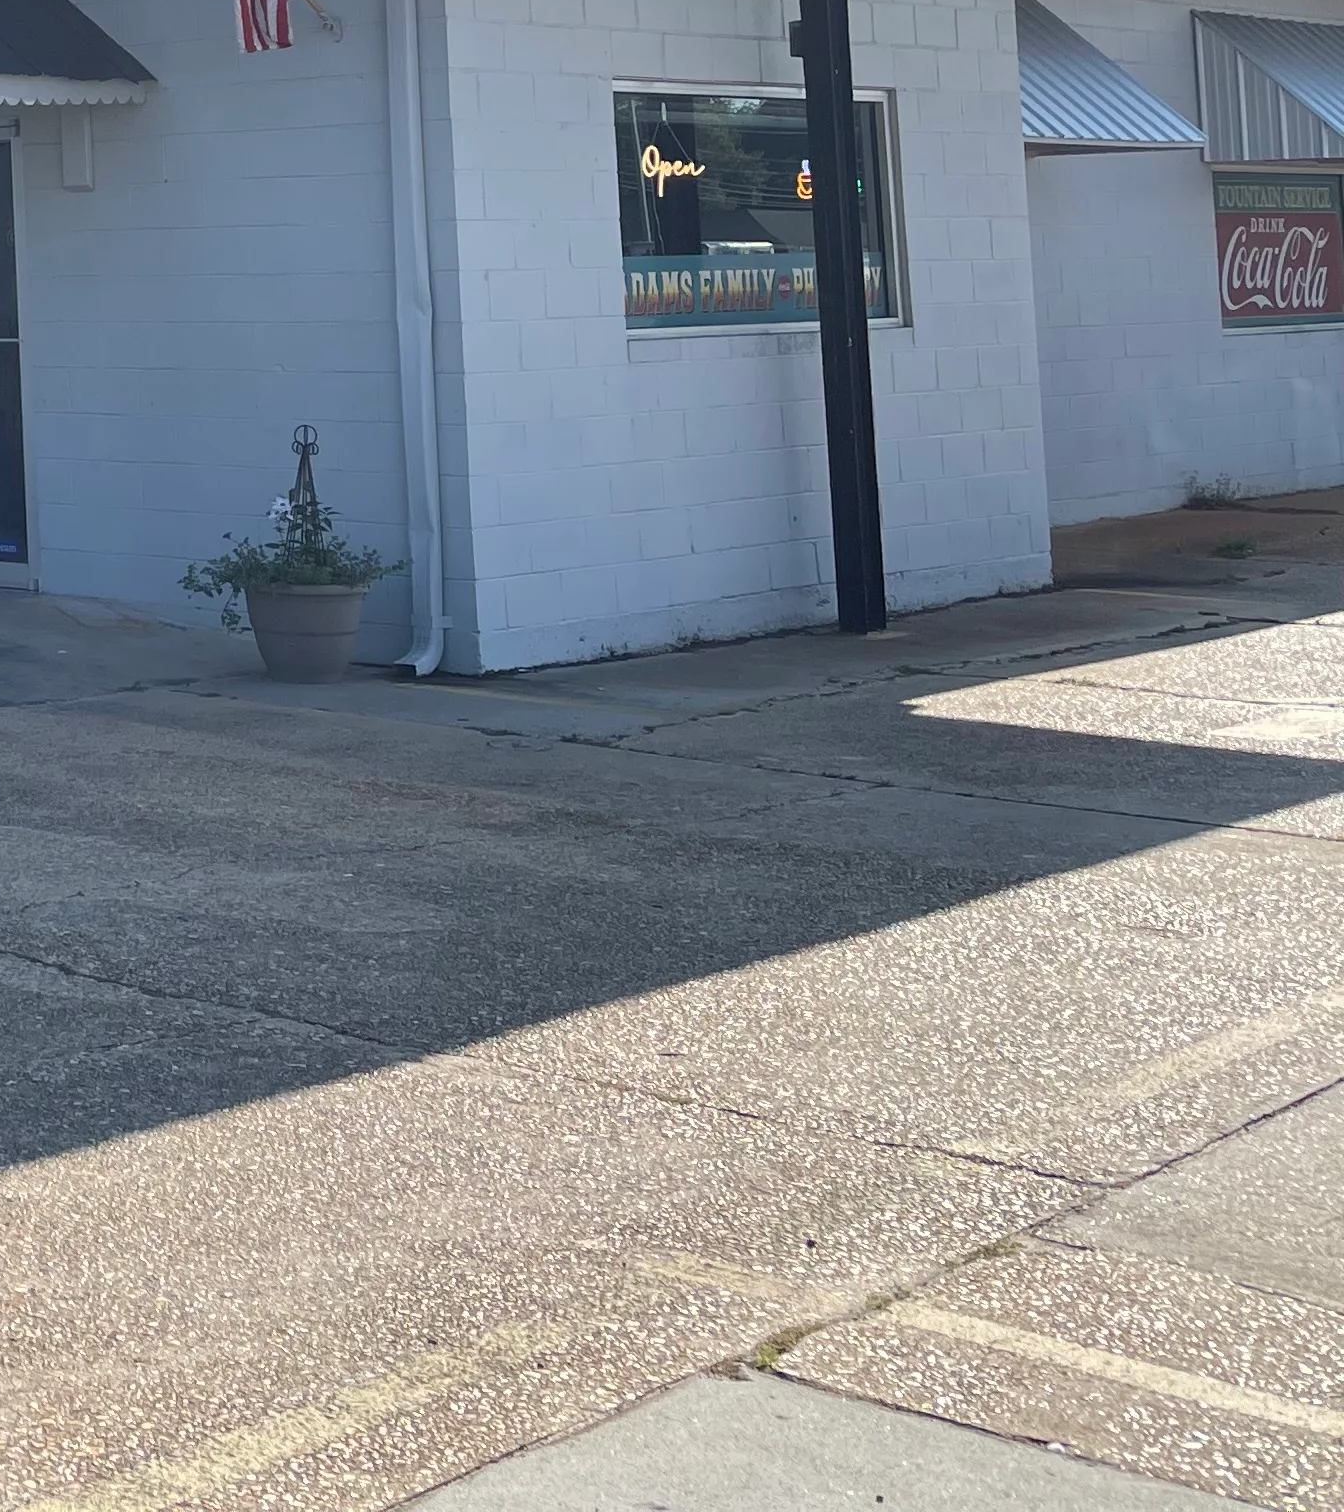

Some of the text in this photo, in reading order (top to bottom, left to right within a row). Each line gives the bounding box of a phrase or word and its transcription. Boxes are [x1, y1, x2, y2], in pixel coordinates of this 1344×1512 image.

[641, 144, 706, 198] Open
[1217, 185, 1333, 209] FOUNTAIN SERVICE
[1250, 217, 1286, 233] DRINK
[698, 267, 777, 313] FAMILY
[1221, 225, 1330, 311] Coca-Cola
